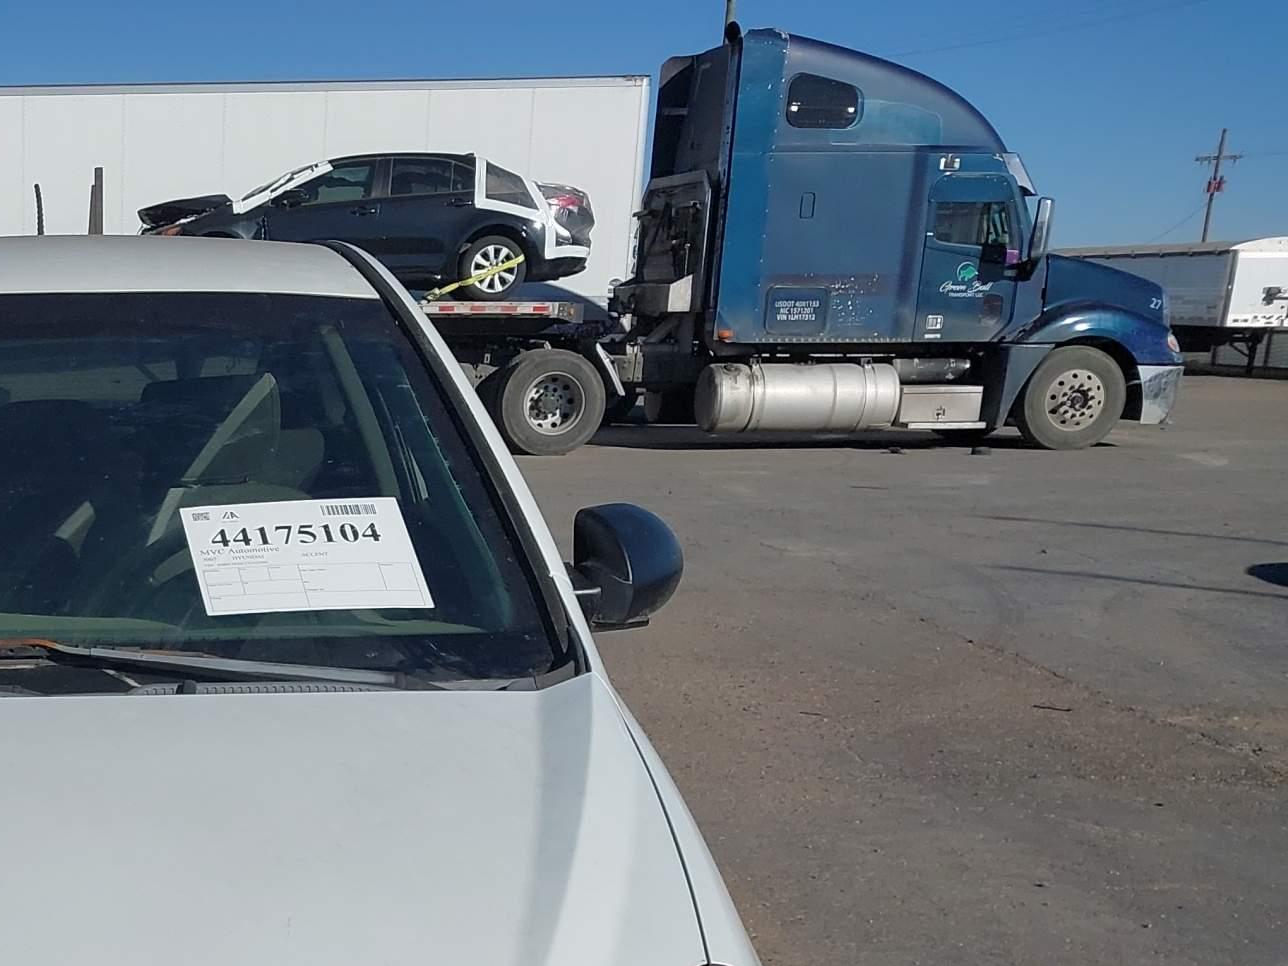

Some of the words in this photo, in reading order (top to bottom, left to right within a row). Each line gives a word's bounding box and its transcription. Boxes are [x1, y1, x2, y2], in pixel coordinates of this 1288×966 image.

[1149, 297, 1162, 310] 27
[211, 522, 382, 548] 44175104
[200, 548, 225, 556] MVC
[228, 546, 281, 555] Automotive
